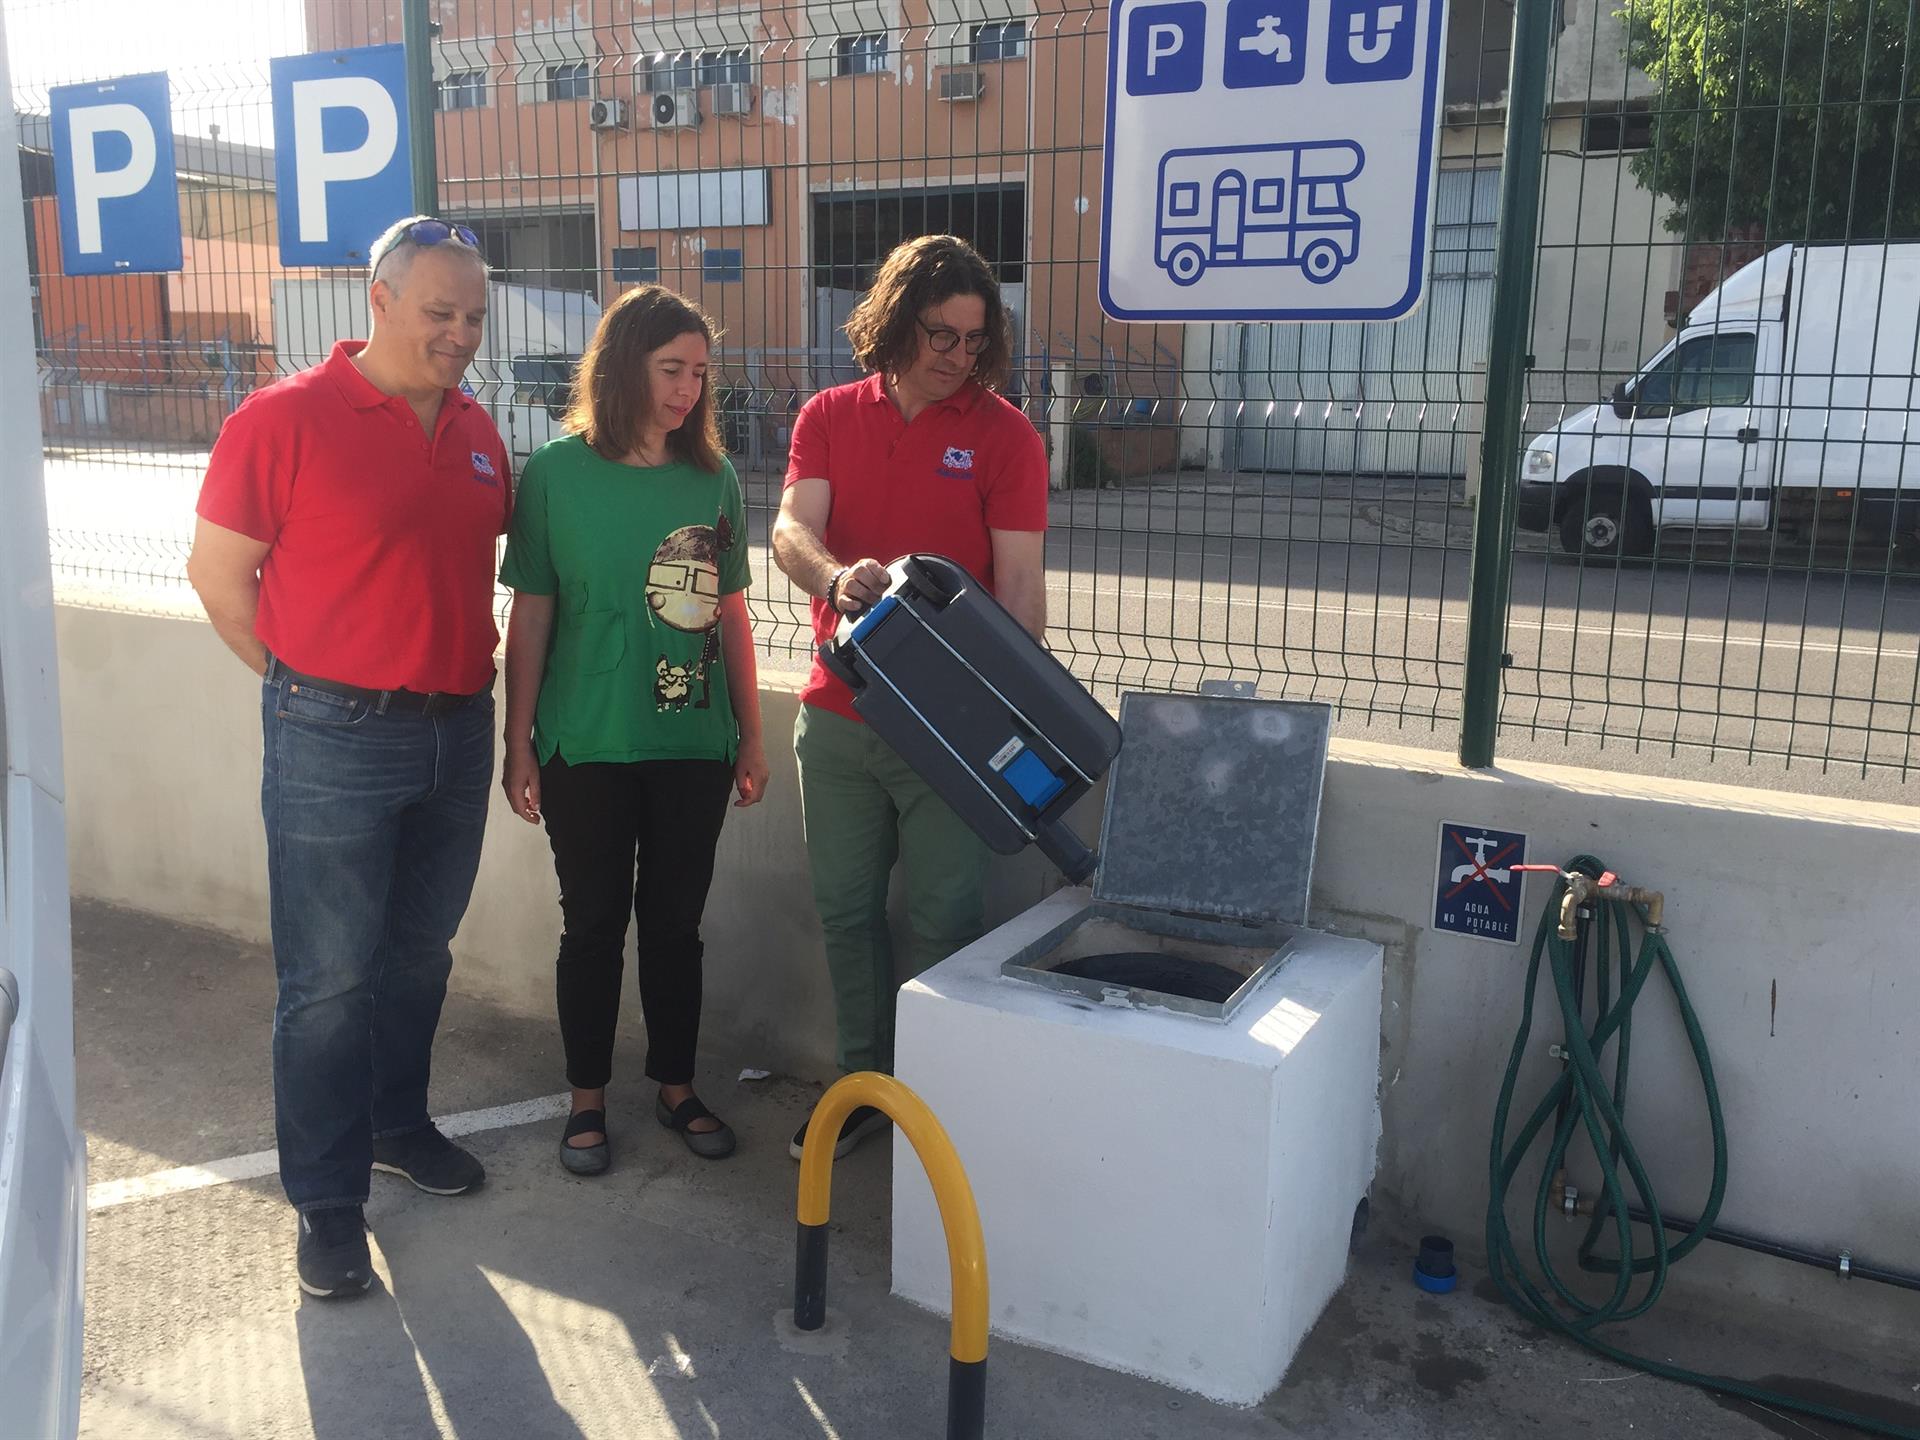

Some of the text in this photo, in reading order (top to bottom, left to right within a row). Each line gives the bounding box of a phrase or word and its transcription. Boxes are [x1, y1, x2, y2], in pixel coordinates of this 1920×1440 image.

[1147, 23, 1184, 76] P
[68, 103, 157, 254] P
[292, 76, 398, 242] P
[1443, 913, 1509, 933] NO POTABLE
[1464, 902, 1489, 914] AGUA
